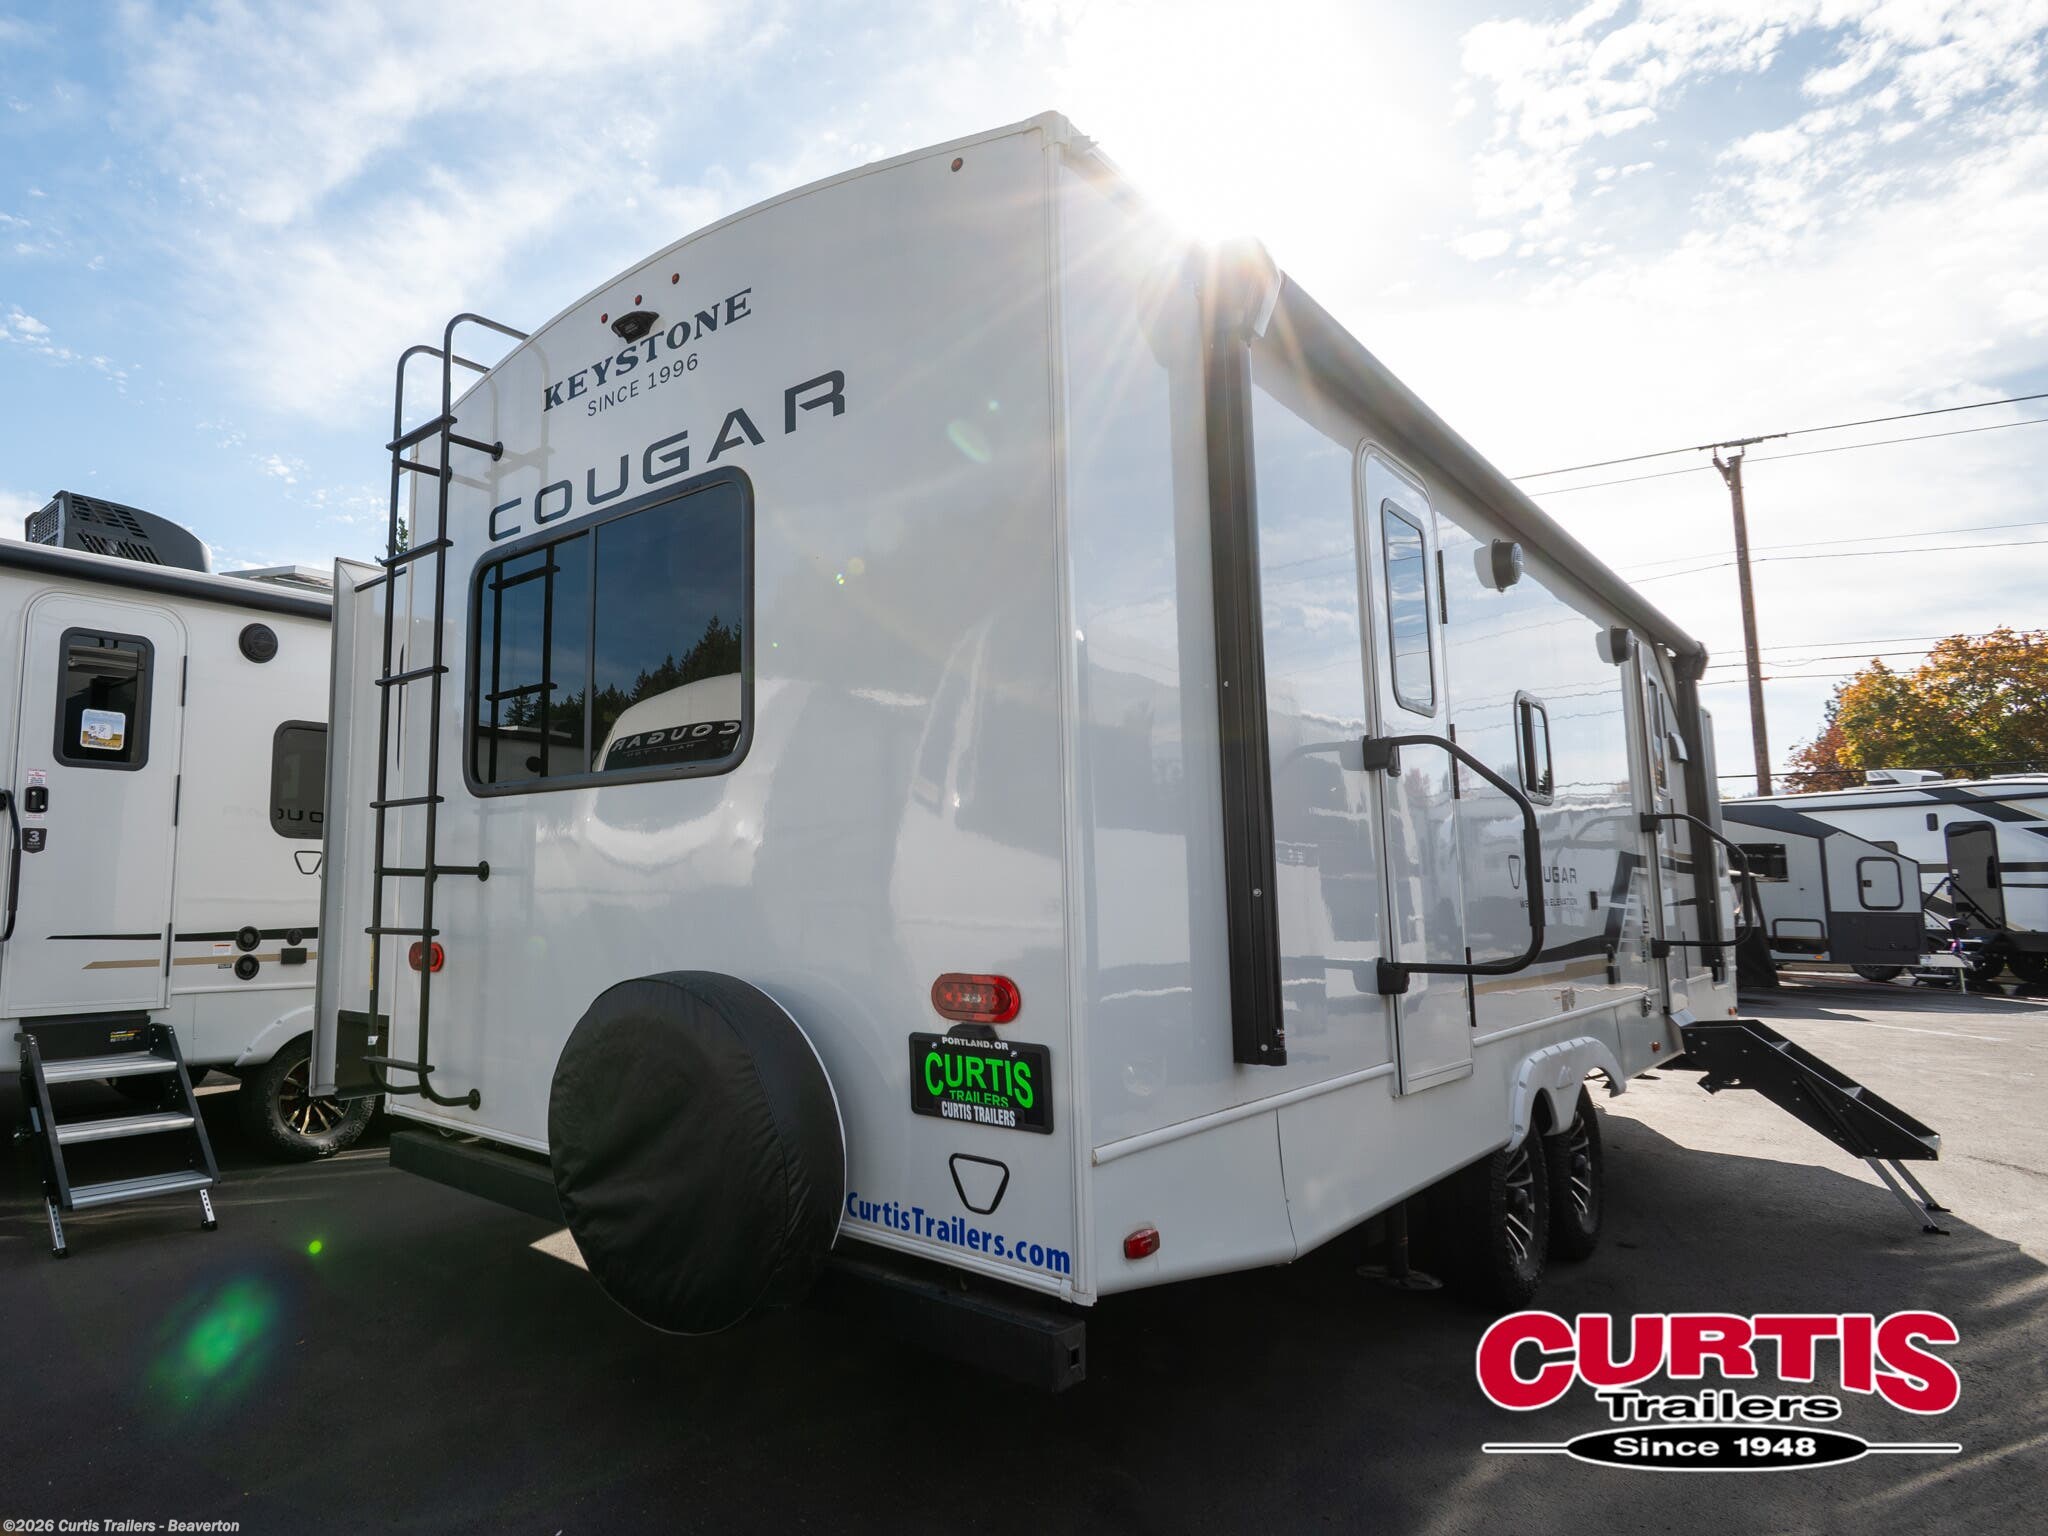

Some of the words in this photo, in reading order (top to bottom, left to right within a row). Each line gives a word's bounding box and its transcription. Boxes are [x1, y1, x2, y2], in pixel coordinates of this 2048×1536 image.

[544, 288, 752, 412] KEYSTONE
[587, 380, 639, 417] SINCE
[648, 353, 699, 391] 1996
[489, 370, 846, 542] COUGAR
[29, 830, 40, 842] 3
[1543, 866, 1577, 883] UGAR
[941, 1037, 993, 1049] PORTLAND,
[994, 1041, 1009, 1050] OR
[925, 1052, 1034, 1109] CURTIS
[949, 1090, 1009, 1107] TRAILERS
[941, 1101, 972, 1121] CURTIS
[973, 1106, 1016, 1127] TRAILERS
[847, 1192, 1070, 1274] CurtisTrailers.com
